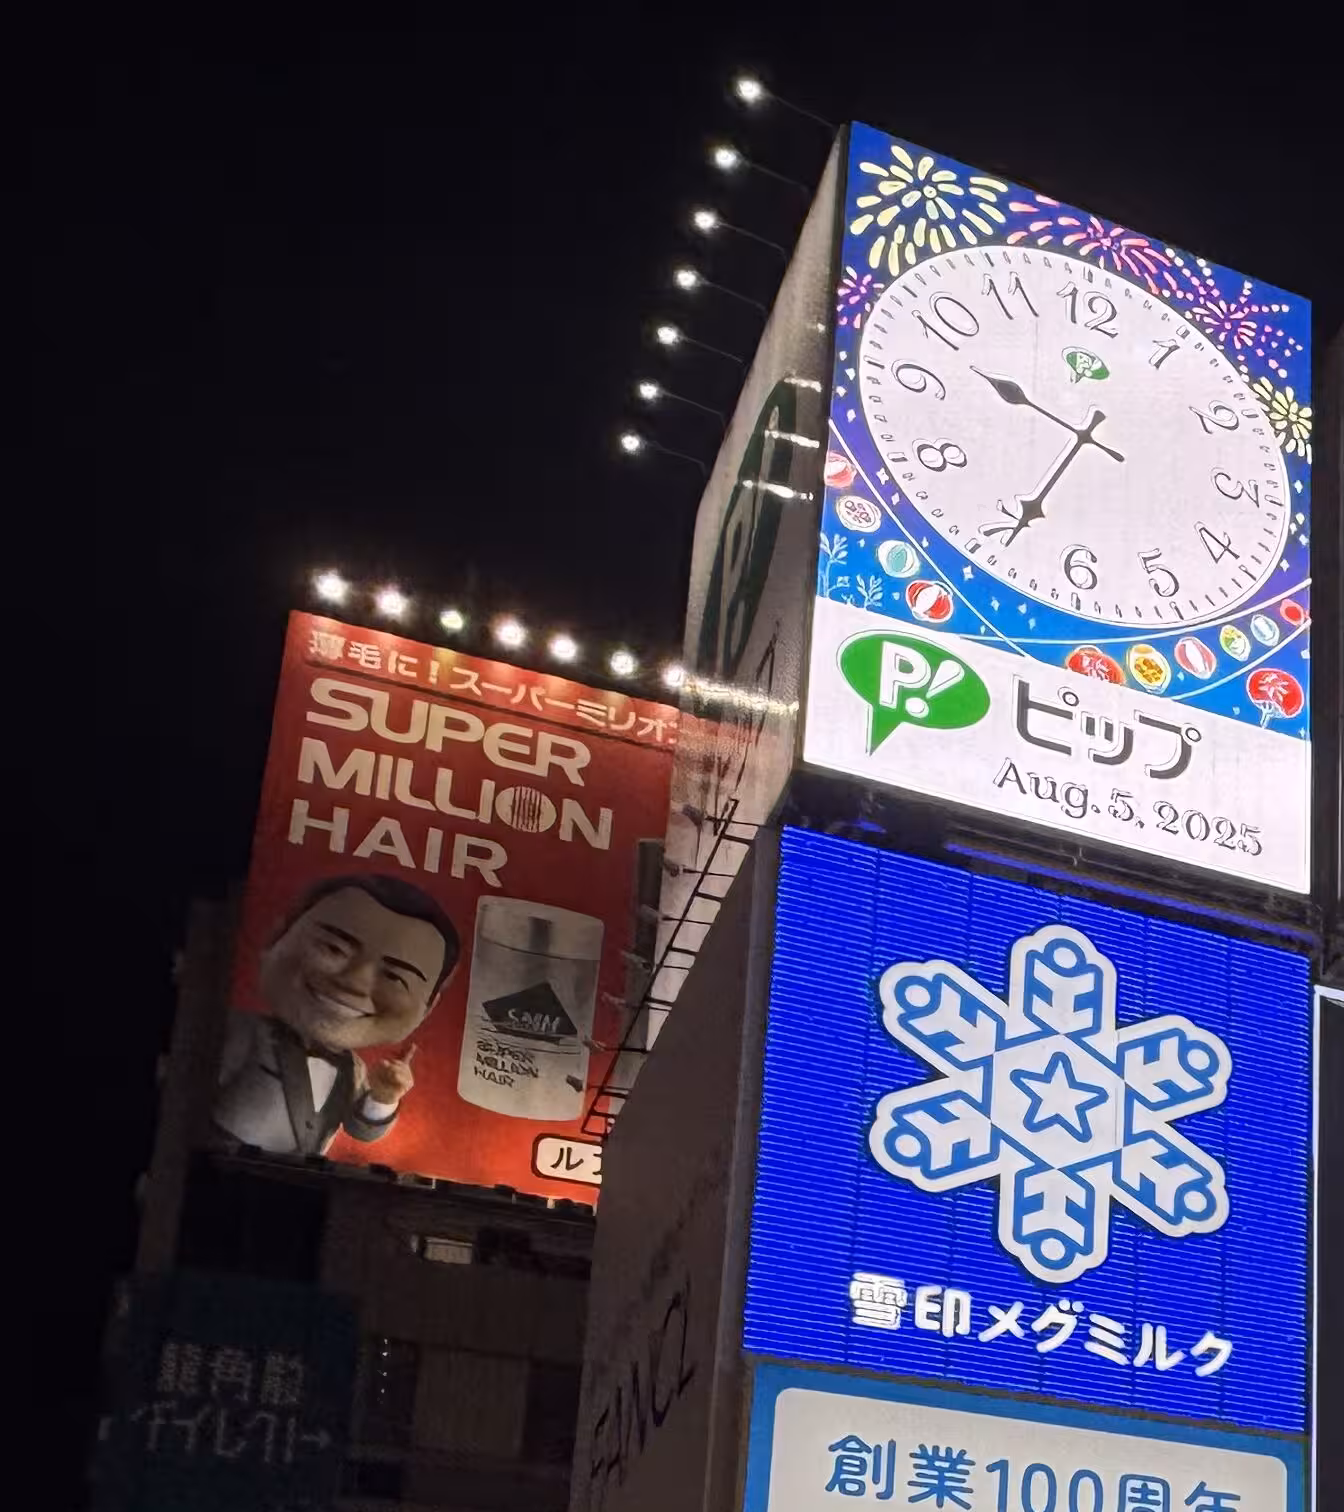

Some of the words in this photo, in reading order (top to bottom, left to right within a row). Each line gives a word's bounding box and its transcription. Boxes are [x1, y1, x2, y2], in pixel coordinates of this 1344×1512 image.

[980, 271, 1040, 322] 11
[1056, 281, 1120, 341] 12
[914, 292, 980, 353] 10
[1150, 337, 1184, 370] 1
[890, 359, 947, 402] 9
[1189, 398, 1241, 436] 2
[916, 438, 968, 475] 8
[1210, 465, 1261, 508] 3
[1061, 543, 1101, 592] 6
[1191, 519, 1238, 568] 4
[1136, 548, 1182, 599] 5
[304, 678, 592, 787] SUPER
[1013, 673, 1203, 780] ピップ
[297, 737, 613, 850] MILLION
[992, 757, 1100, 823] Aug.
[1153, 799, 1265, 859] 2025
[288, 799, 507, 888] HAIR
[849, 1271, 1233, 1377] 雪印メグミルク
